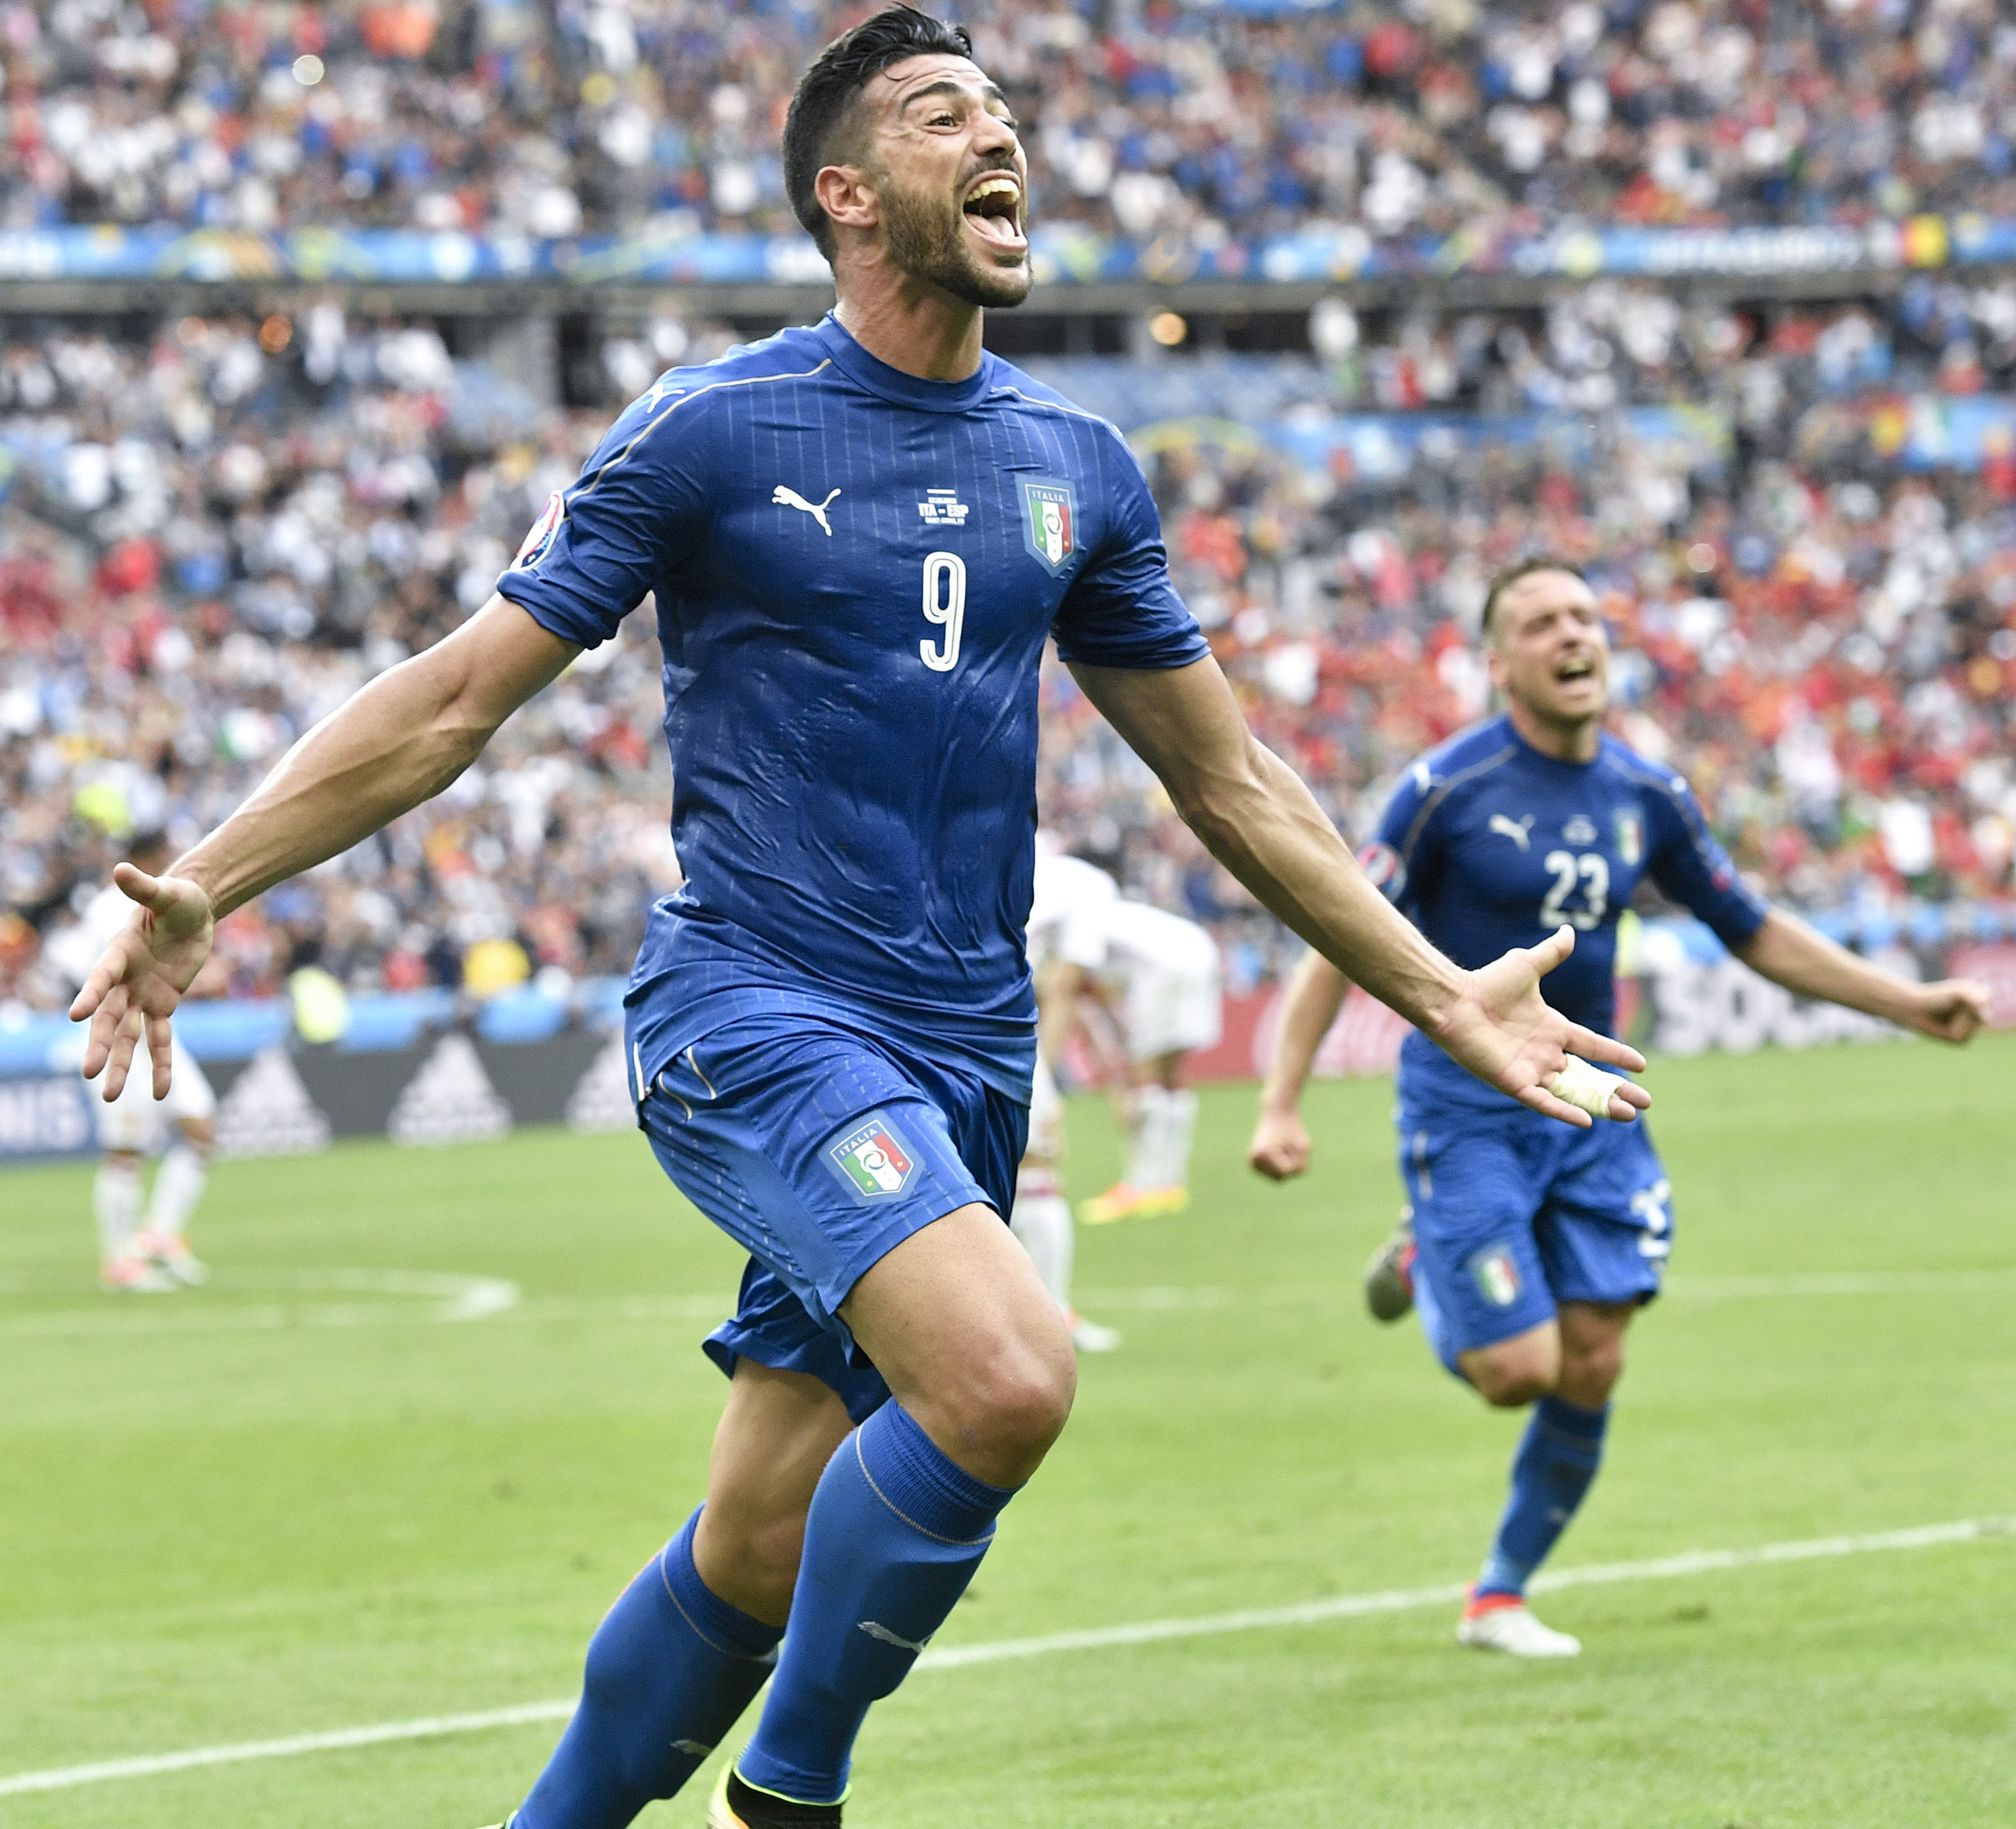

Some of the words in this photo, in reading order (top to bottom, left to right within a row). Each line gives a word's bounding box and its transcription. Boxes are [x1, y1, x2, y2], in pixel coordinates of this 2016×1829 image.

[918, 503, 938, 517] ITA
[946, 504, 969, 517] ESP
[1032, 490, 1065, 503] ITALIA
[920, 551, 967, 672] 9
[1540, 849, 1610, 932] 23
[839, 1128, 878, 1156] ITALIA
